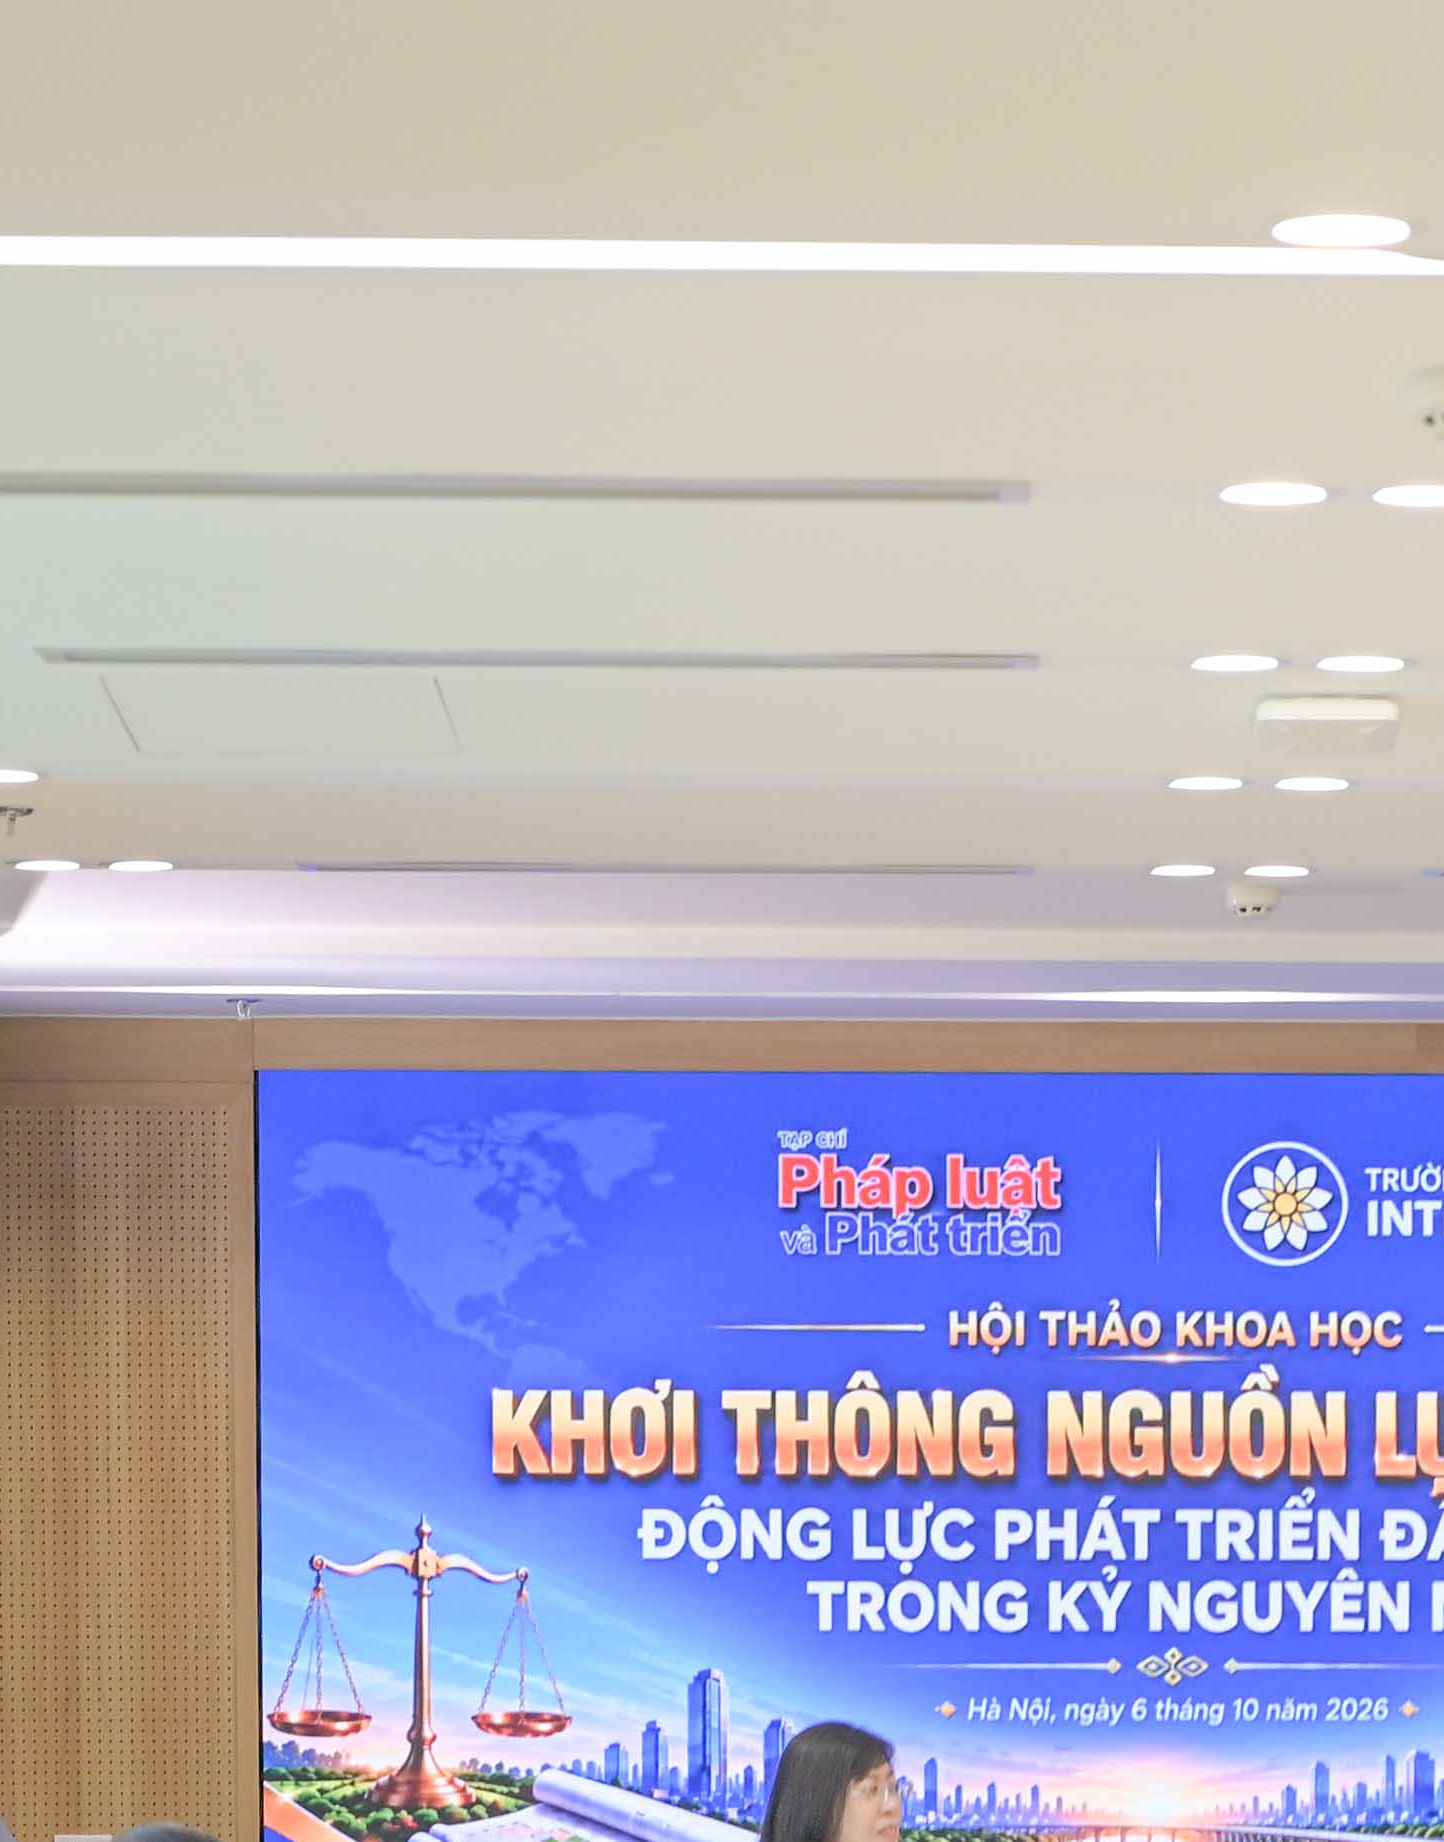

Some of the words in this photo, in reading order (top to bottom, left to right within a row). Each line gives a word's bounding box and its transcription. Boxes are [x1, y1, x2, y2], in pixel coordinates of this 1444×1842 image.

[777, 1130, 813, 1151] TẠP
[816, 1128, 847, 1149] CHÍ
[778, 1152, 933, 1220] Pháp
[946, 1152, 1062, 1218] luật
[780, 1225, 817, 1255] và
[825, 1211, 939, 1256] Phát
[946, 1209, 1062, 1256] triển
[948, 1302, 1026, 1356] HỘI
[1039, 1298, 1162, 1348] THẢO
[1176, 1310, 1297, 1348] KHOA
[1310, 1310, 1404, 1356] HỌC
[491, 1378, 697, 1478] KHƠI
[721, 1370, 1016, 1479] THÔNG
[1047, 1363, 1347, 1479] NGUỒN
[637, 1495, 833, 1575] ĐỘNG
[852, 1501, 976, 1576] LỰC
[994, 1496, 1161, 1562] PHÁT
[1175, 1487, 1360, 1562] TRIỂN
[807, 1579, 1029, 1633] TRONG
[1048, 1566, 1132, 1633] KỶ
[1148, 1568, 1410, 1634] NGUYÊN
[967, 1698, 1002, 1721] Hà
[1008, 1697, 1056, 1726] Nội,
[1064, 1700, 1125, 1727] ngày
[1131, 1698, 1147, 1721] 6
[1155, 1697, 1224, 1727] tháng
[1232, 1698, 1259, 1721] 10
[1266, 1699, 1318, 1721] năm
[1325, 1698, 1389, 1721] 2026
